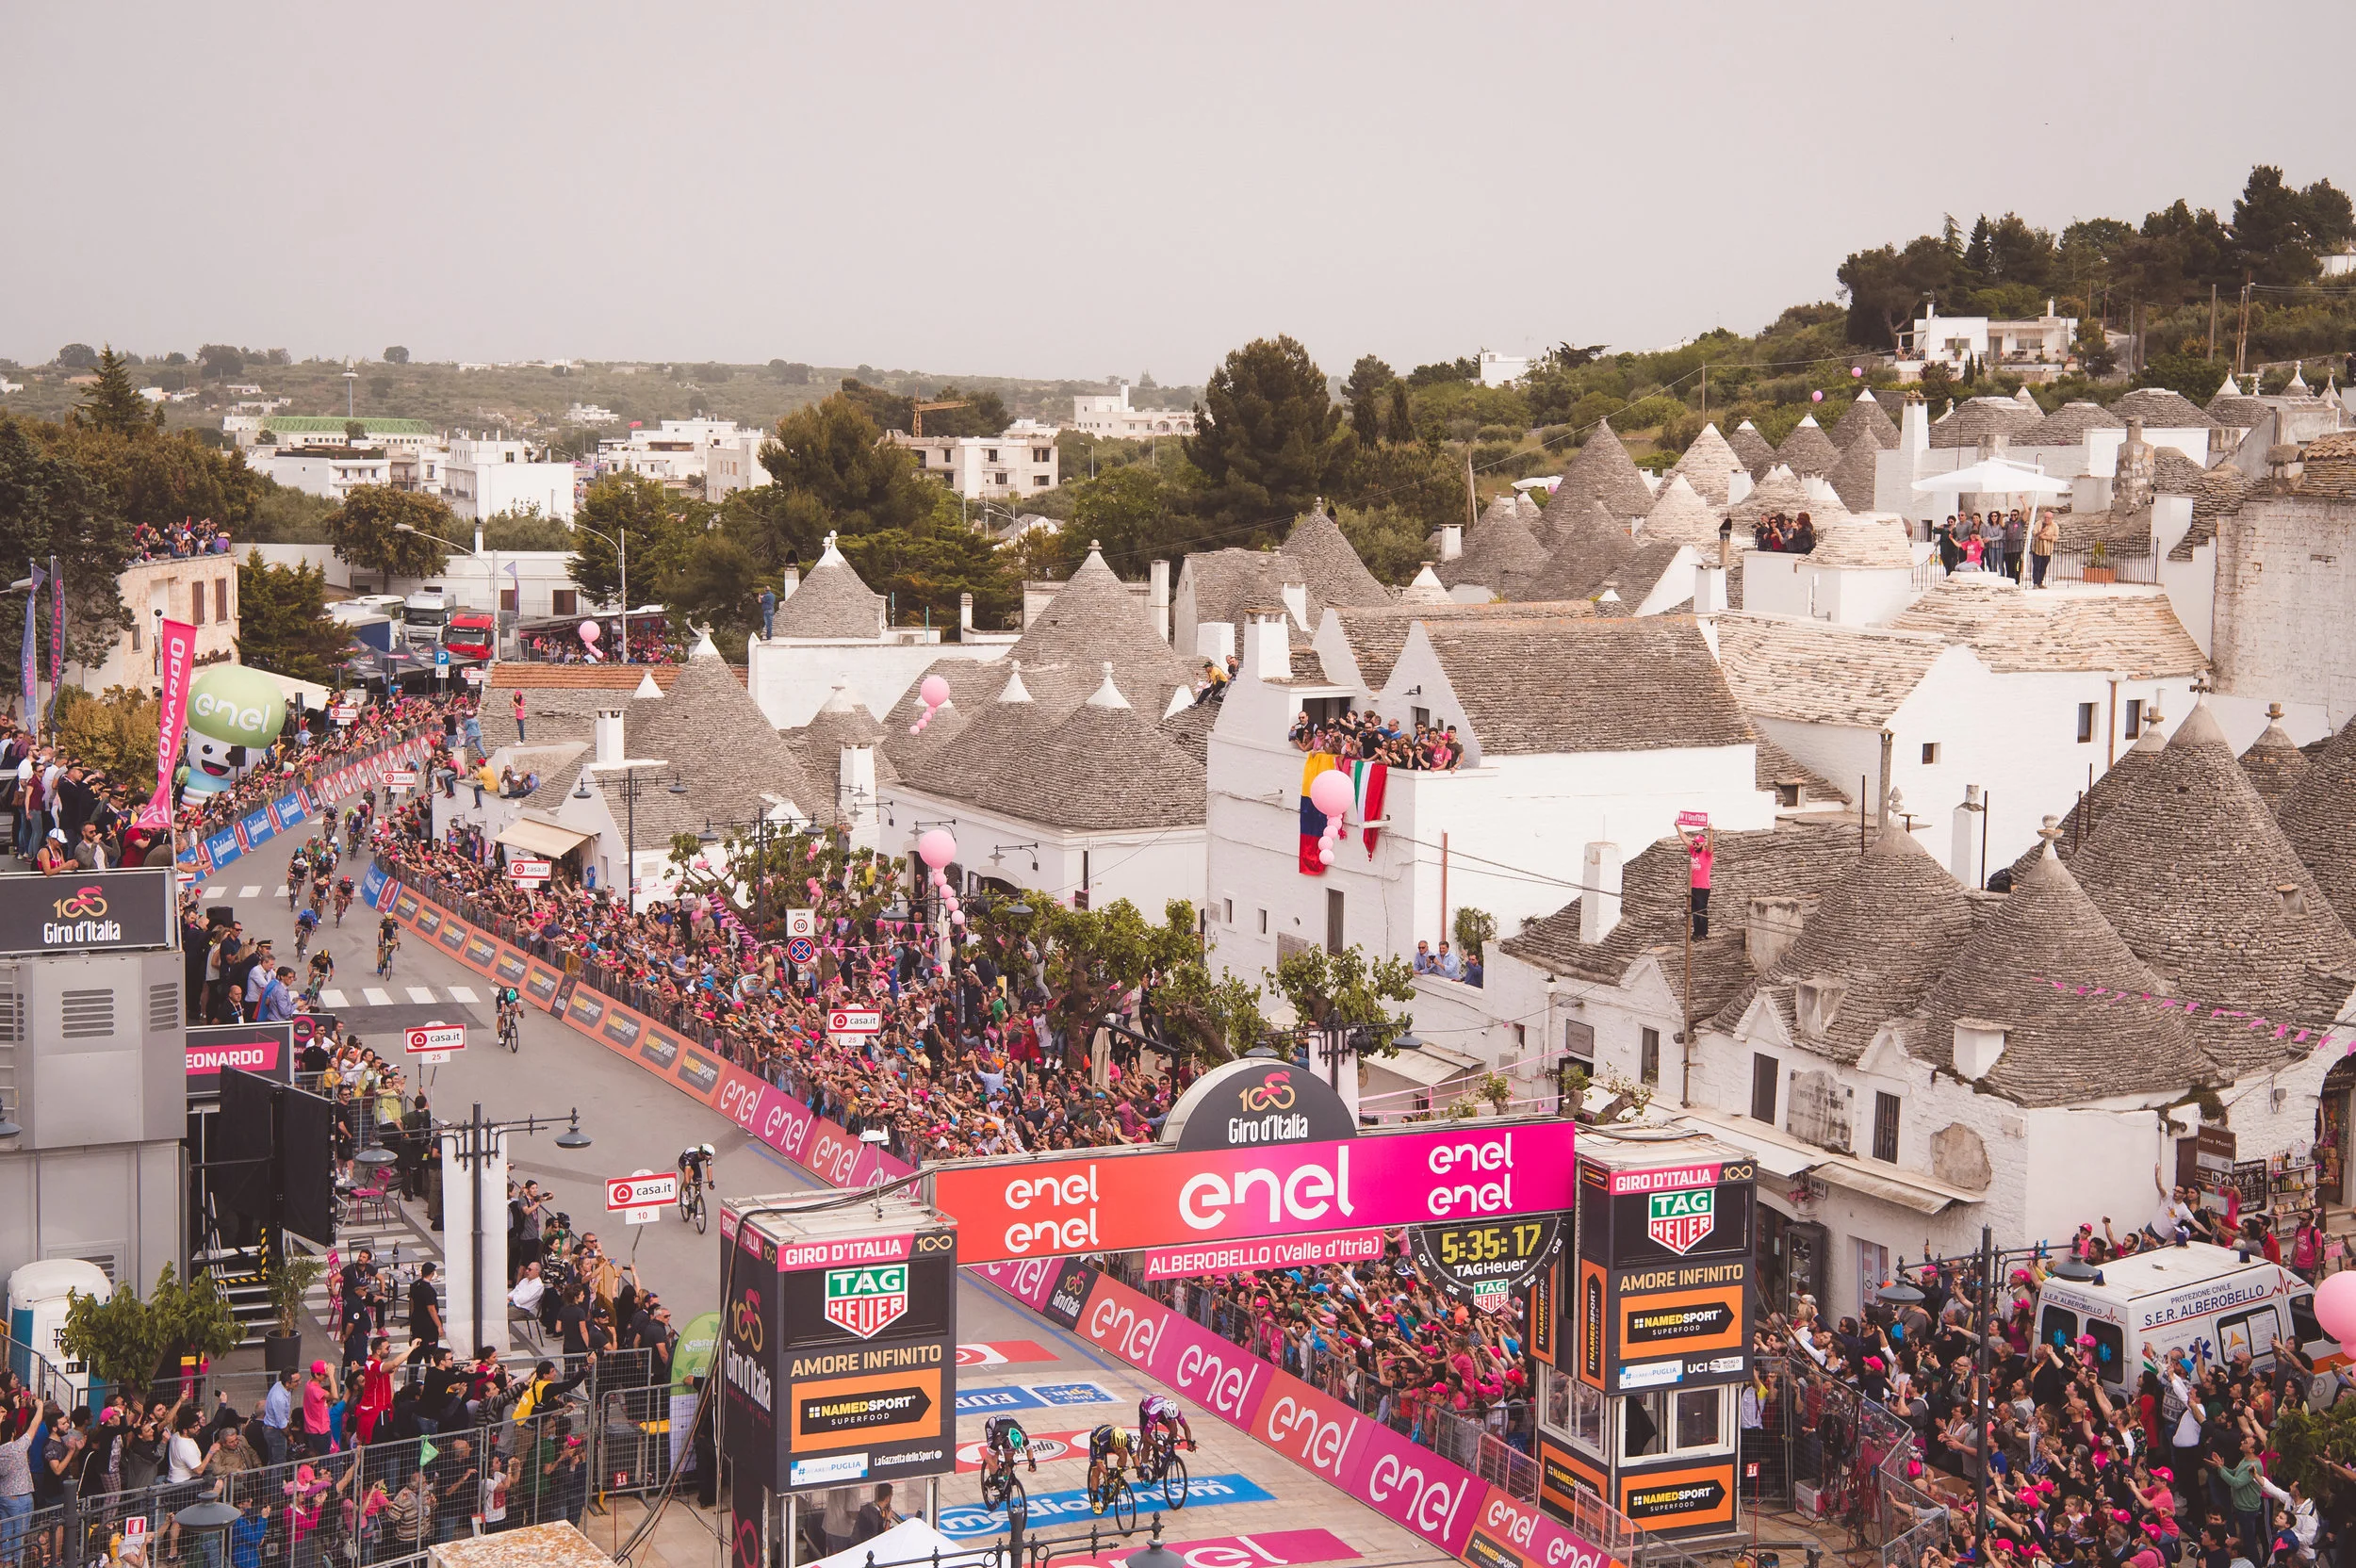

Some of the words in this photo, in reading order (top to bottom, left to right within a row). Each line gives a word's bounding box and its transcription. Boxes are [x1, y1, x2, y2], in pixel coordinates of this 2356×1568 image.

[438, 652, 447, 664] P
[158, 637, 186, 774] EONARDO
[194, 693, 270, 734] enel
[43, 922, 74, 944] Giro
[74, 920, 122, 942] d'Italia
[849, 1016, 876, 1025] casa.it
[430, 1032, 461, 1042] casa.it
[186, 1049, 264, 1069] EONARDO
[719, 1077, 764, 1125] enel
[764, 1104, 812, 1156] enel
[1228, 1117, 1258, 1144] Giro
[1260, 1113, 1308, 1142] d'Italia
[812, 1135, 863, 1187] enel
[1428, 1133, 1513, 1175] enel
[636, 1183, 672, 1198] casa.it
[1005, 1165, 1100, 1210] enel
[1178, 1145, 1355, 1230] enel
[1614, 1172, 1651, 1192] GIRO
[1653, 1168, 1712, 1187] D'ITALIA
[1428, 1173, 1513, 1217] enel
[1653, 1192, 1708, 1215] TAG
[637, 1211, 648, 1220] 10
[722, 1214, 736, 1237] GIRO
[741, 1228, 760, 1254] ITALIA
[1005, 1208, 1100, 1253] enel
[1652, 1215, 1710, 1252] HEUER
[785, 1246, 828, 1266] GIRO
[831, 1239, 902, 1262] D'ITALIA
[1148, 1245, 1270, 1275] ALBEROBELLO
[1274, 1239, 1322, 1265] (Valle
[1325, 1235, 1380, 1260] d'Itria)
[1552, 1237, 1563, 1254] 20
[1417, 1252, 1430, 1267] 40
[832, 1267, 902, 1296] TAG
[988, 1258, 1053, 1301] nel
[1445, 1283, 1460, 1296] 35
[1476, 1281, 1507, 1294] TAG
[1522, 1274, 1537, 1288] 25
[1619, 1271, 1675, 1292] AMORE
[1677, 1264, 1744, 1285] INFINITO
[1475, 1293, 1507, 1313] HEUER
[2060, 1296, 2102, 1315] ALBEROBELLO
[2145, 1308, 2178, 1327] S.E.R.
[2180, 1284, 2265, 1318] ALBEROBELLO
[2170, 1287, 2211, 1305] PROTEZIONE
[2212, 1282, 2232, 1294] CIVILE
[830, 1296, 903, 1336] HEUER
[1644, 1311, 1718, 1328] NAMEDSPORT
[1652, 1324, 1701, 1335] SUPERFOOD
[1090, 1298, 1170, 1368] enel
[790, 1354, 859, 1378] AMORE
[863, 1344, 942, 1369] INFINITO
[1687, 1363, 1708, 1374] UCI
[726, 1339, 744, 1389] Giro
[744, 1354, 771, 1413] d'Italia
[1176, 1344, 1259, 1420] enel
[821, 1396, 910, 1417] NAMEDSPORT
[831, 1413, 890, 1426] SUPERFOOD
[1268, 1396, 1358, 1478] enel
[875, 1458, 881, 1466] La
[881, 1454, 905, 1466] Gazzetta
[905, 1452, 919, 1462] dello
[918, 1449, 935, 1462] Sport
[1368, 1453, 1469, 1543] enel
[1643, 1488, 1711, 1506] NAMEDSPORT
[1650, 1500, 1694, 1512] SUPERFOOD
[1487, 1499, 1540, 1549] enel
